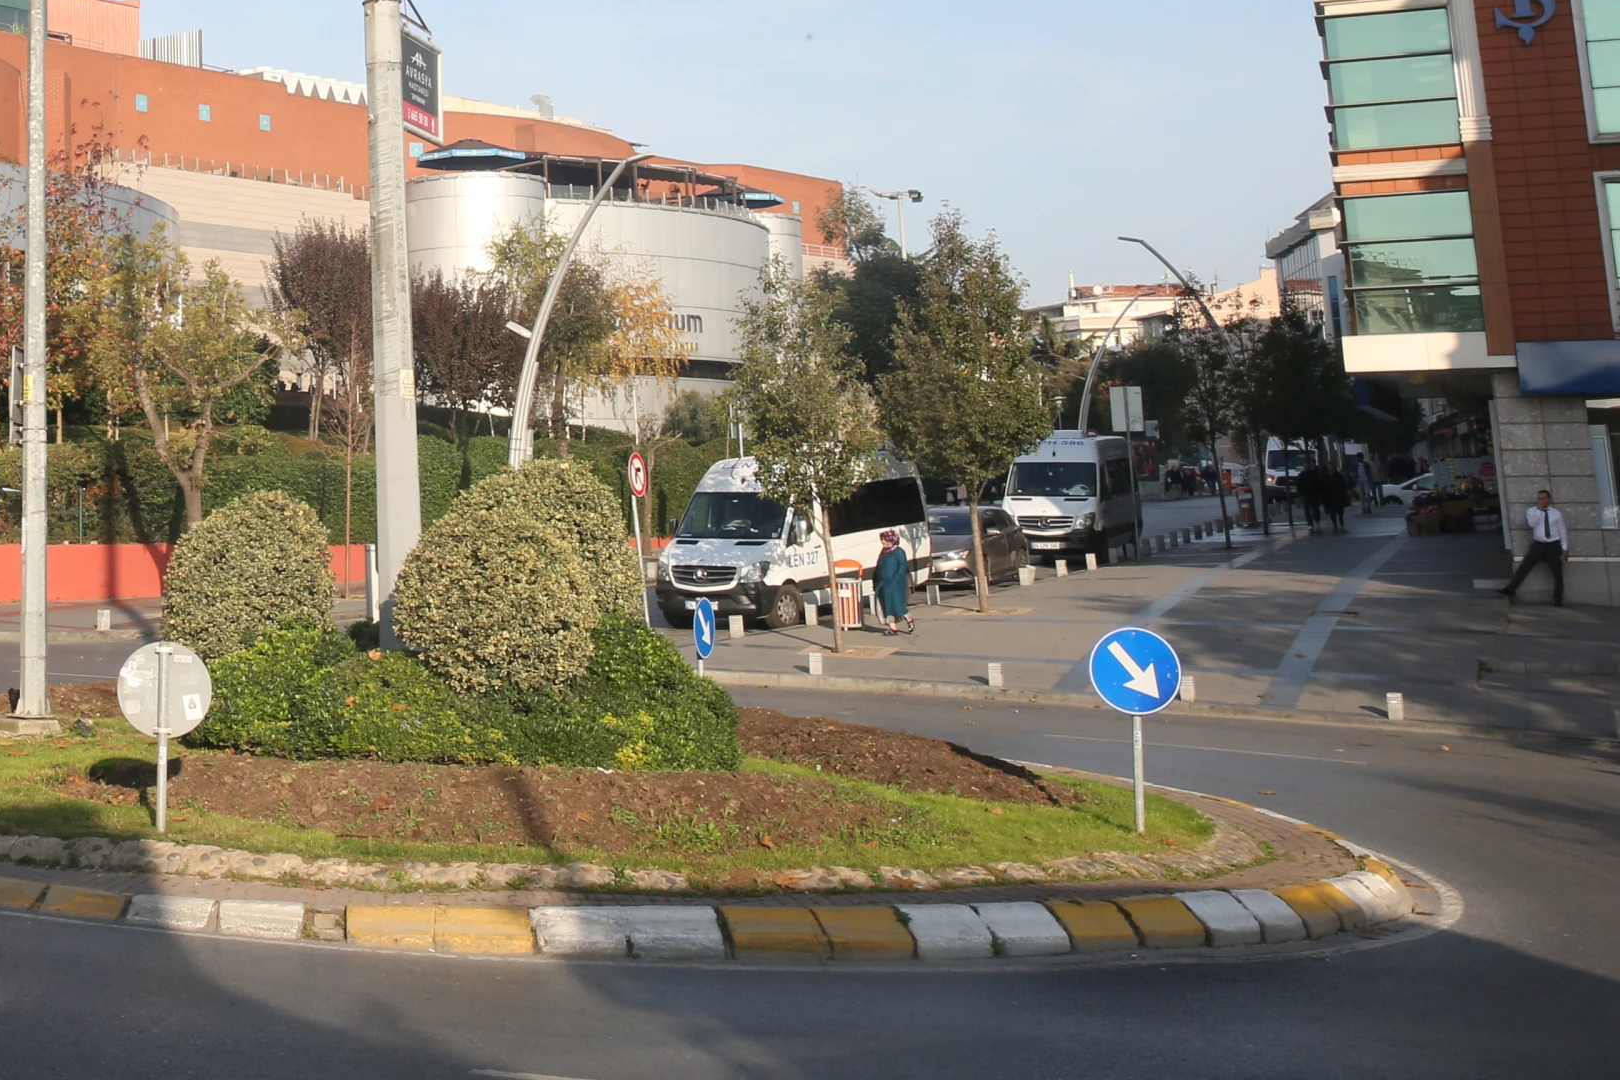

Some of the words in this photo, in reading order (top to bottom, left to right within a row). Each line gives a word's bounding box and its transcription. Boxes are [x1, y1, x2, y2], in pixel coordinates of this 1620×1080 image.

[405, 65, 432, 89] AVRASYA
[788, 552, 805, 568] LEN
[806, 550, 819, 566] 327
